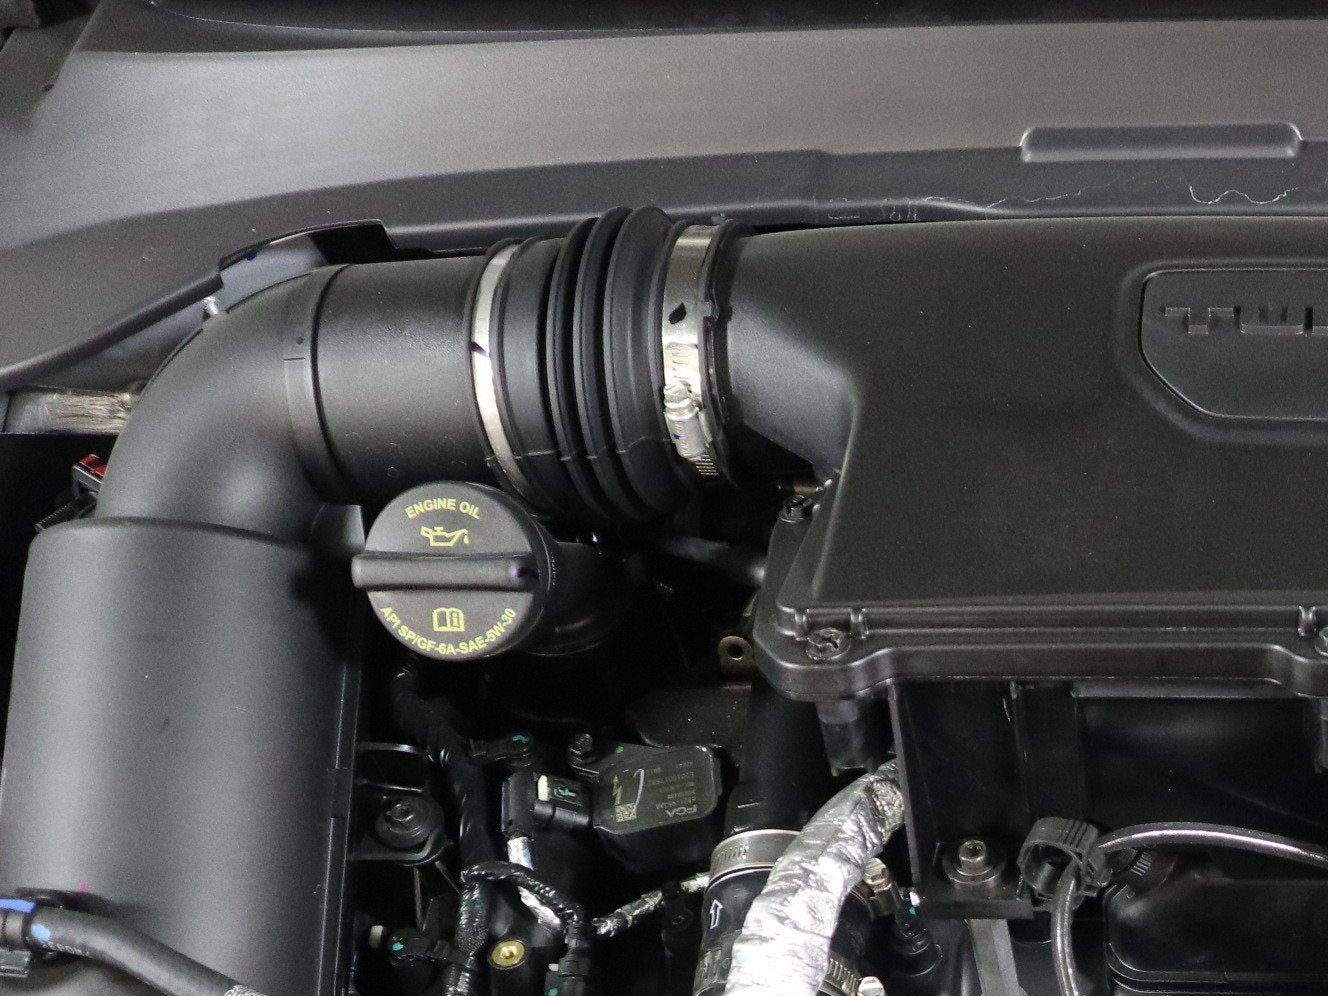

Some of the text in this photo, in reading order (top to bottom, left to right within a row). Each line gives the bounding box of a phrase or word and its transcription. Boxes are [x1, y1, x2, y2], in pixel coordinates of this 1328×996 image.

[404, 498, 481, 520] ENGINE OIL
[380, 607, 400, 629] API
[665, 804, 698, 818] FCA
